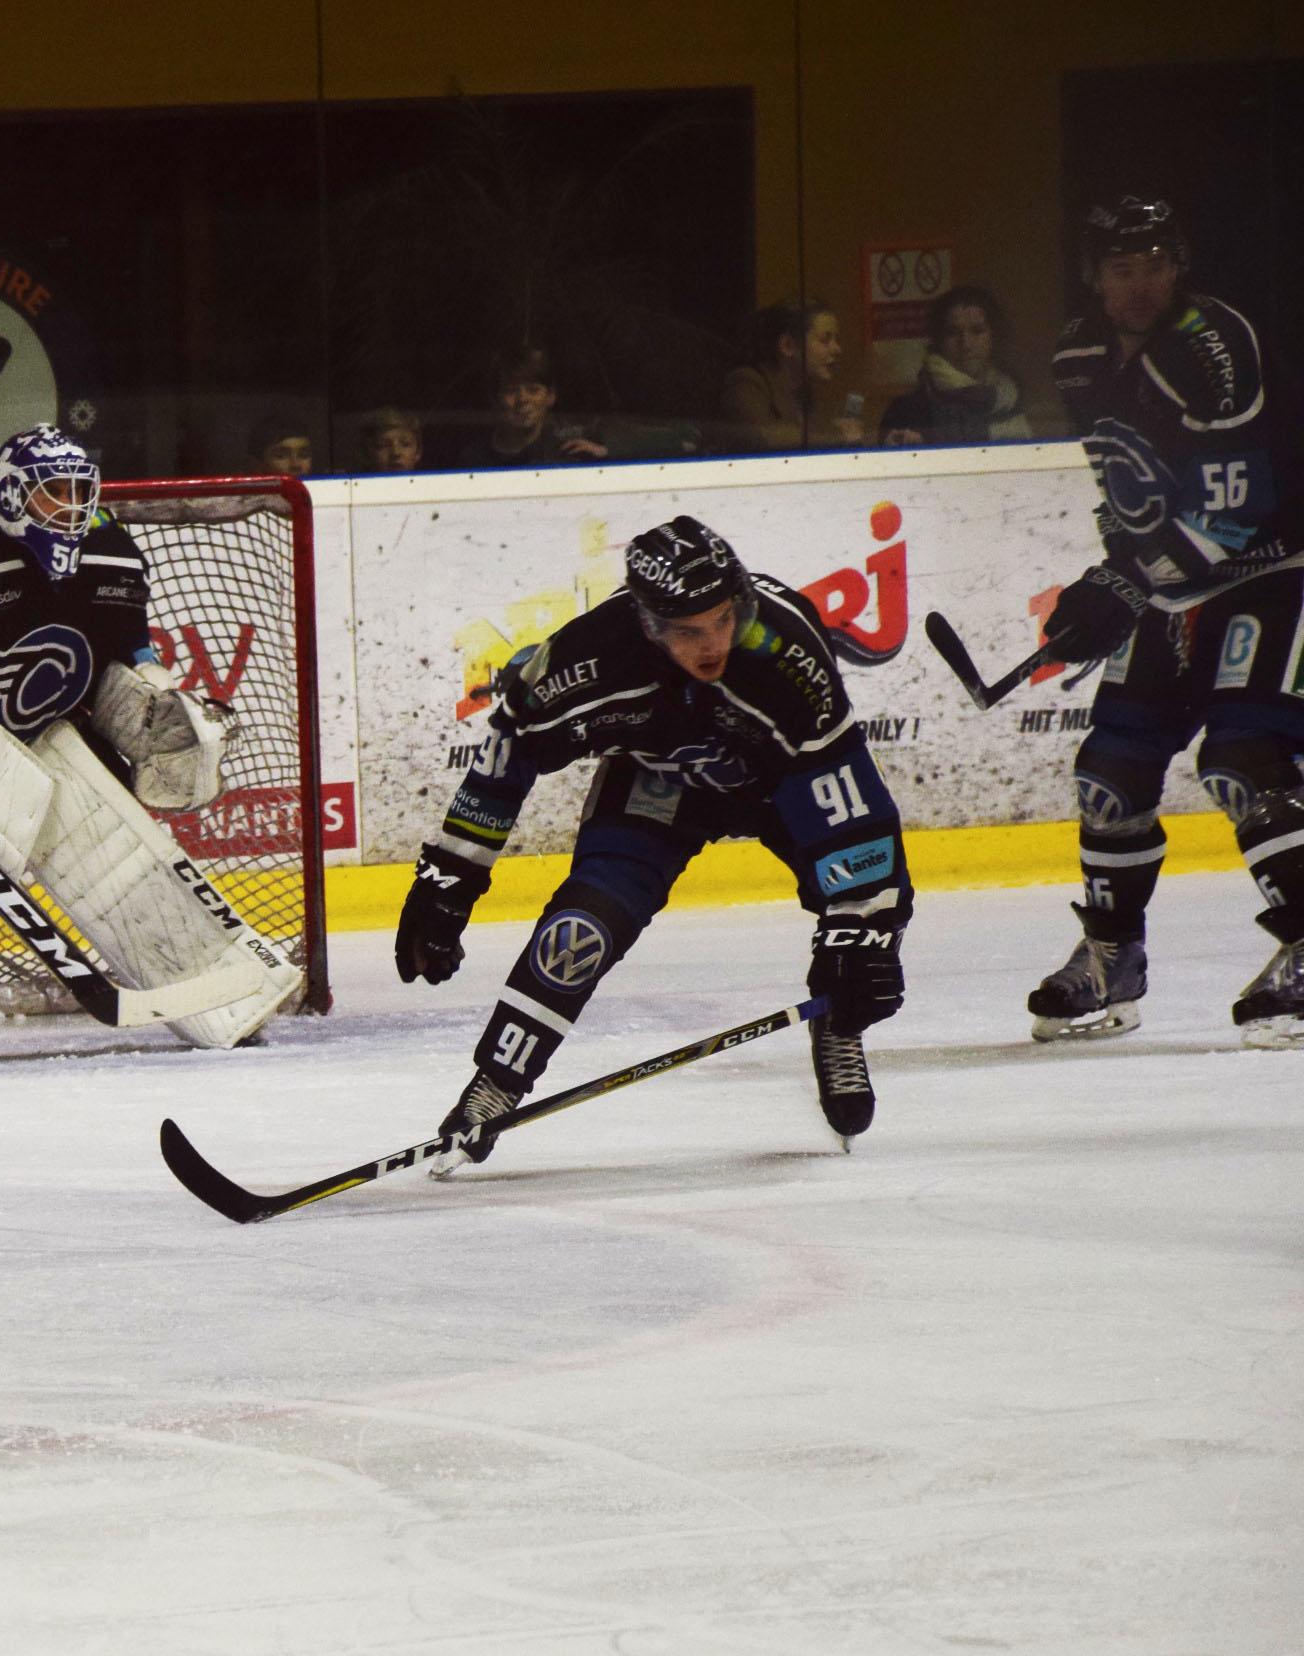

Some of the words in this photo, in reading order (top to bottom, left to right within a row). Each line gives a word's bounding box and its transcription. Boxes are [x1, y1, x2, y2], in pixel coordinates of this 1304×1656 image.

[1201, 460, 1249, 511] 56
[533, 657, 600, 704] BALLET
[1020, 710, 1055, 732] HIT
[1060, 707, 1094, 731] MU
[470, 728, 513, 779] 91
[199, 796, 345, 842] NANTS
[811, 764, 871, 828] 91
[173, 857, 242, 930] CCM
[492, 1021, 540, 1075] 91
[722, 1022, 774, 1049] CCM
[376, 1123, 483, 1179] CCM
